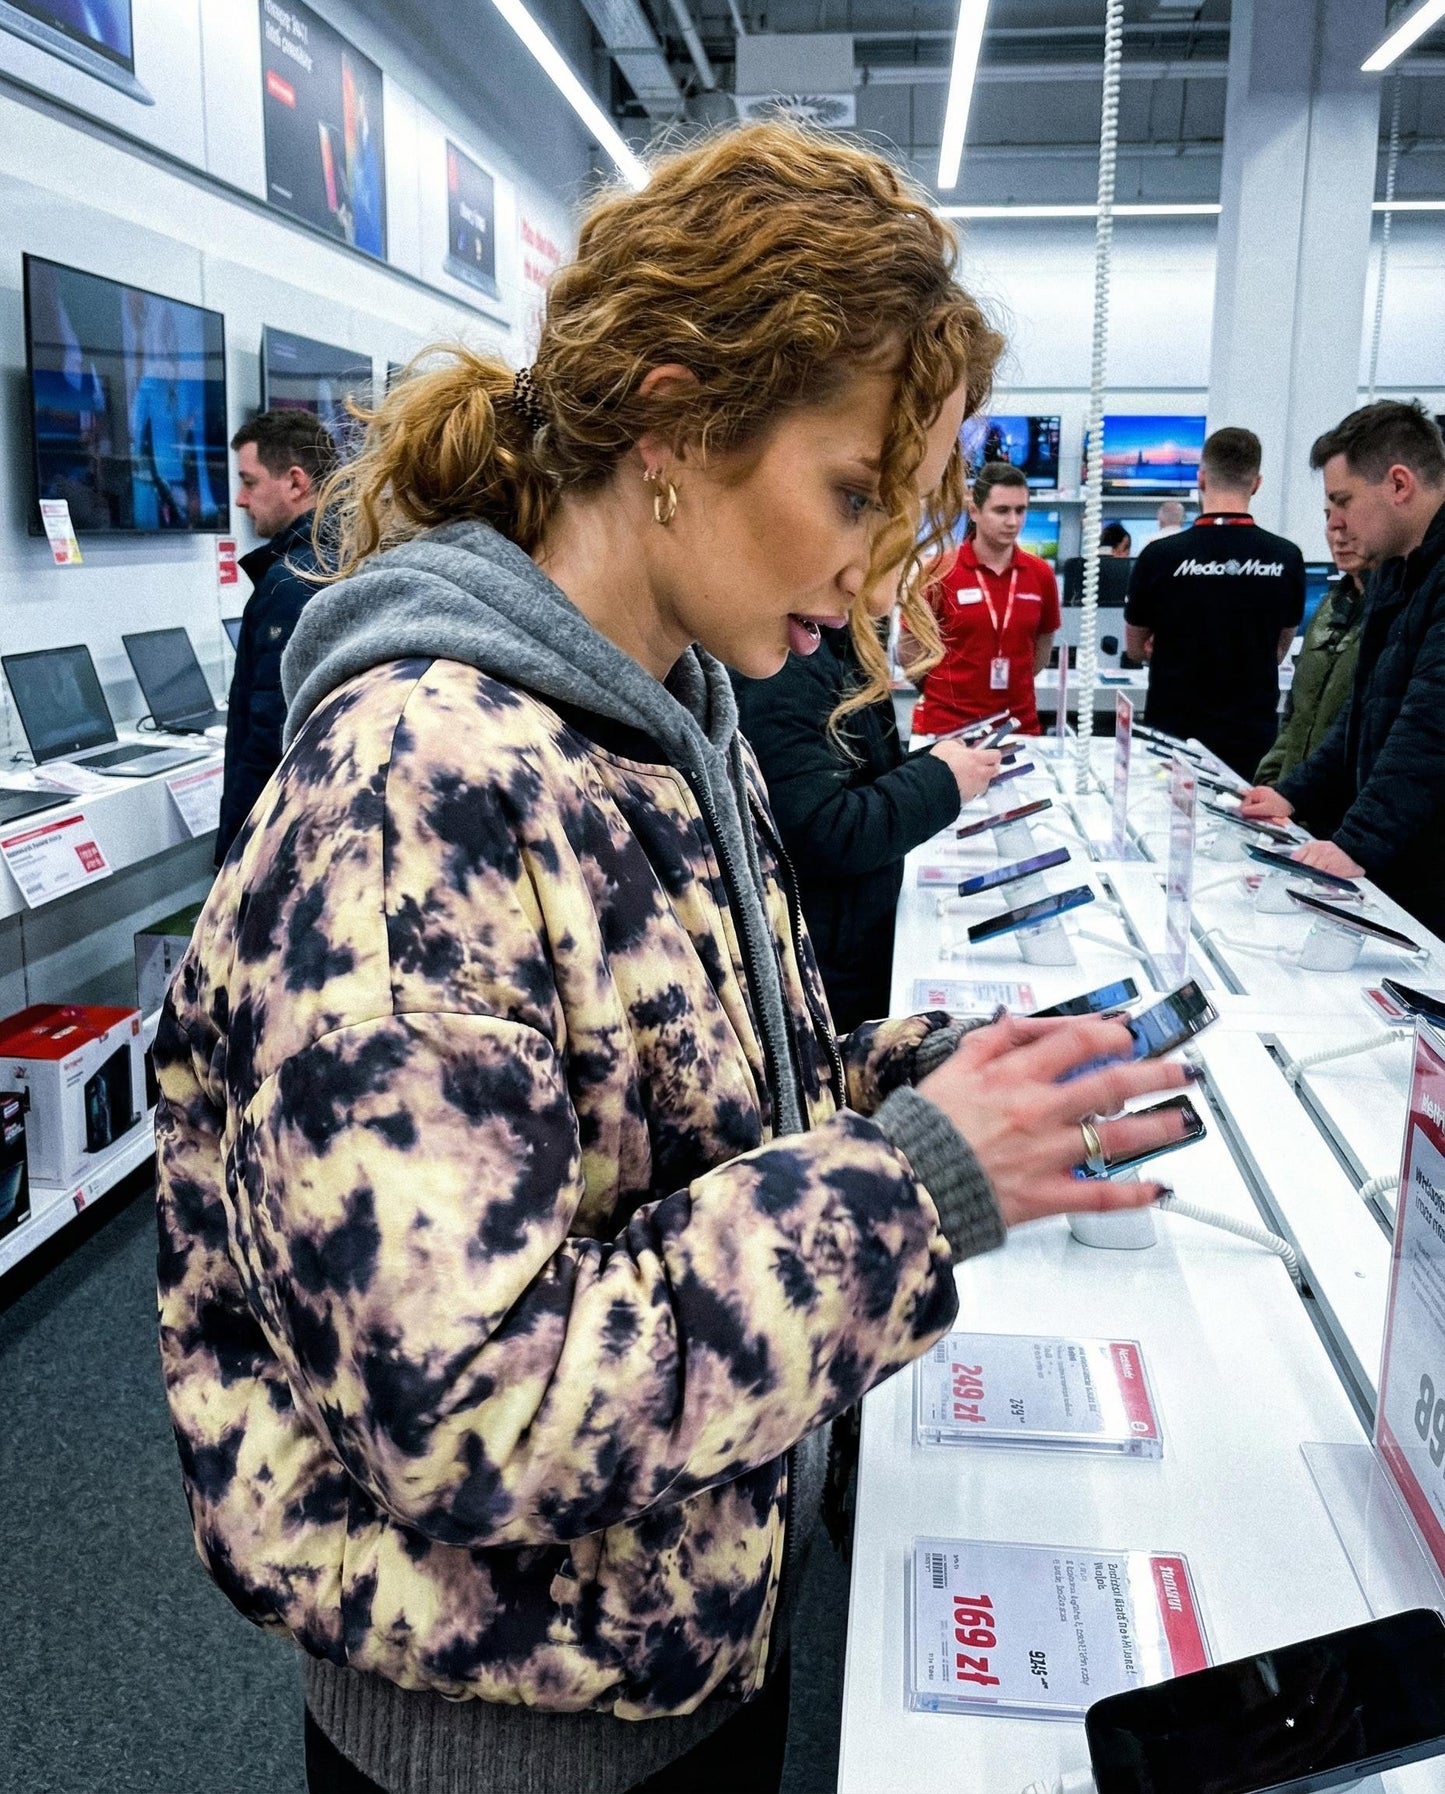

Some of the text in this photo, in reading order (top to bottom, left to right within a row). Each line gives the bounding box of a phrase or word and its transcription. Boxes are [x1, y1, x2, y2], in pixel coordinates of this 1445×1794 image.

[1173, 558, 1285, 577] Media Markt
[951, 1363, 987, 1424] 249 zł
[1413, 1372, 1445, 1480] 89
[953, 1595, 1000, 1686] 169 zł
